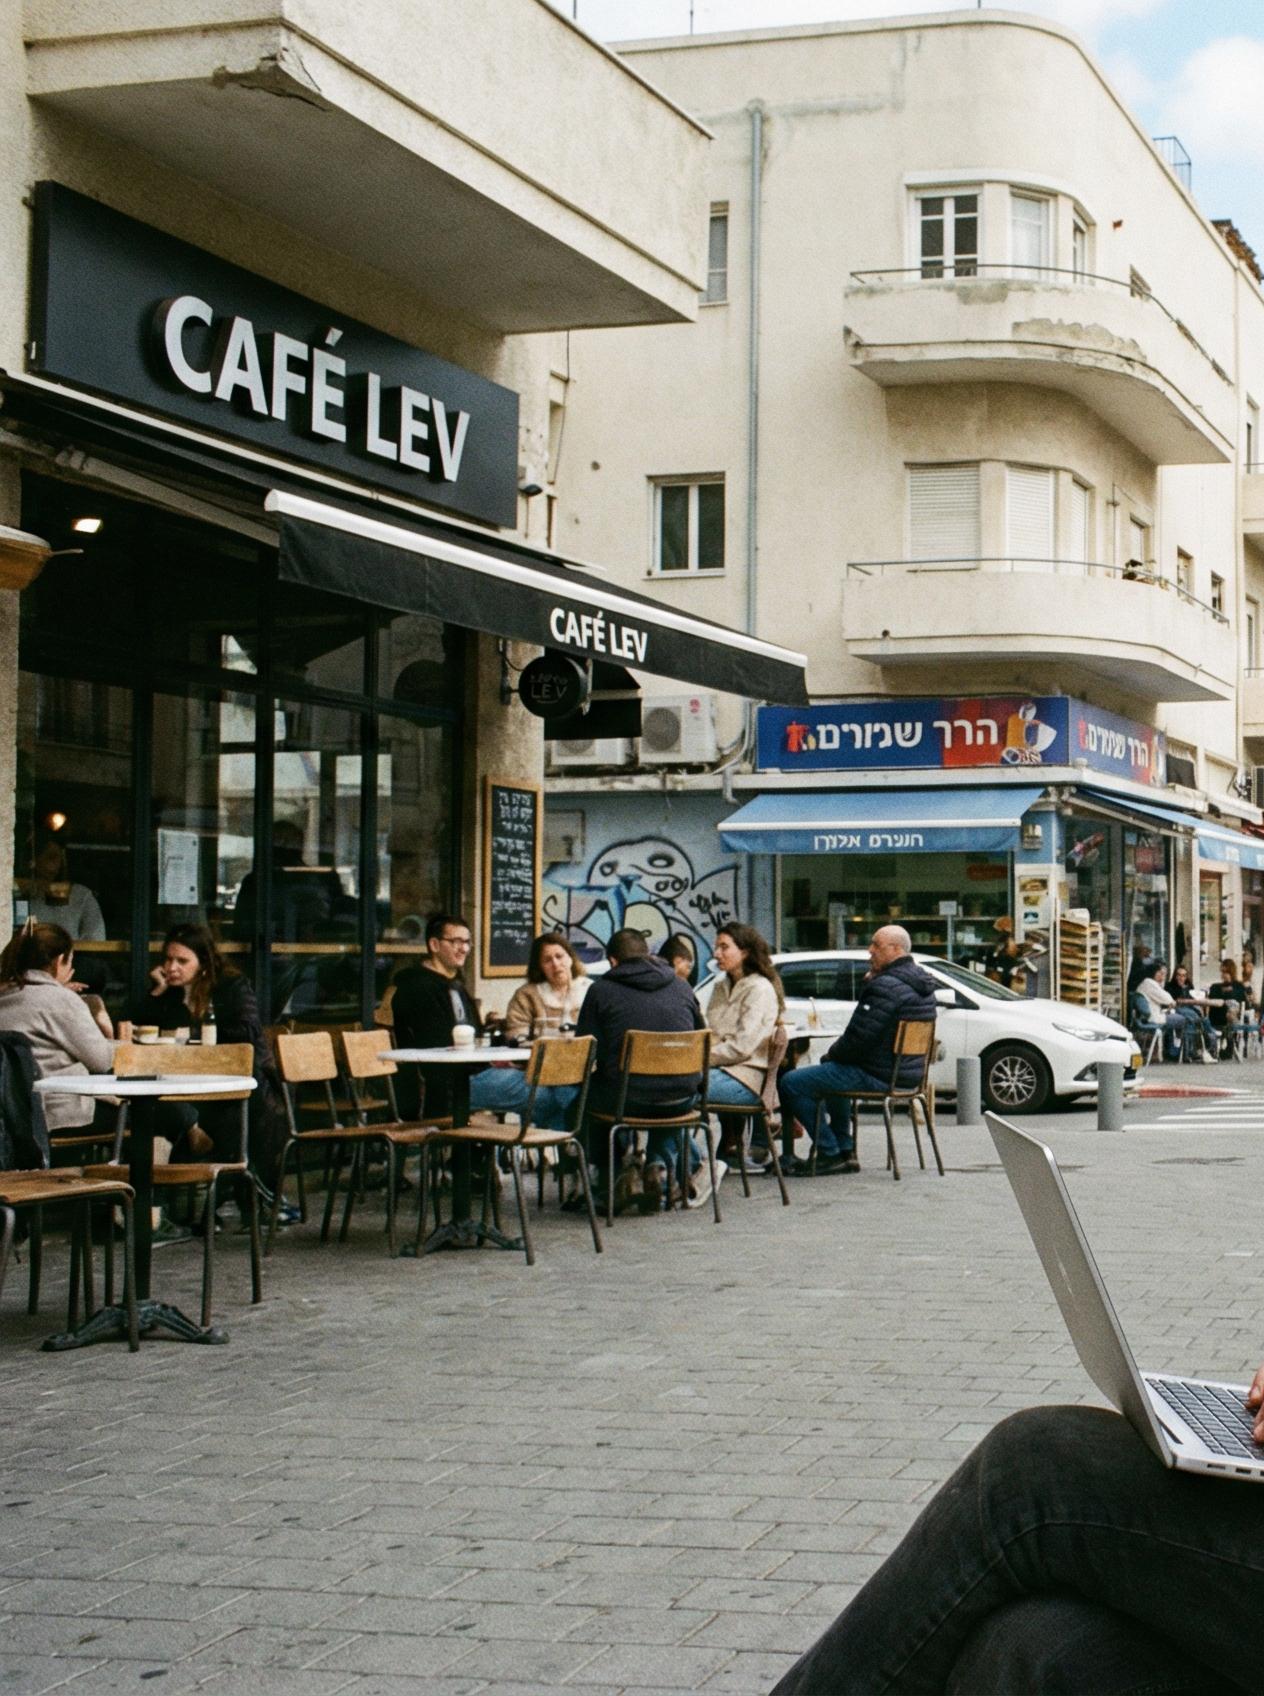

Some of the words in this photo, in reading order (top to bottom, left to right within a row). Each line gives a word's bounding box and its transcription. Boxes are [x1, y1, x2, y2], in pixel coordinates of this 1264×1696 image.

[163, 295, 346, 443] CAFÉ
[366, 371, 471, 483] LEV
[549, 607, 606, 653] CAFÉ
[609, 622, 648, 663] LEV
